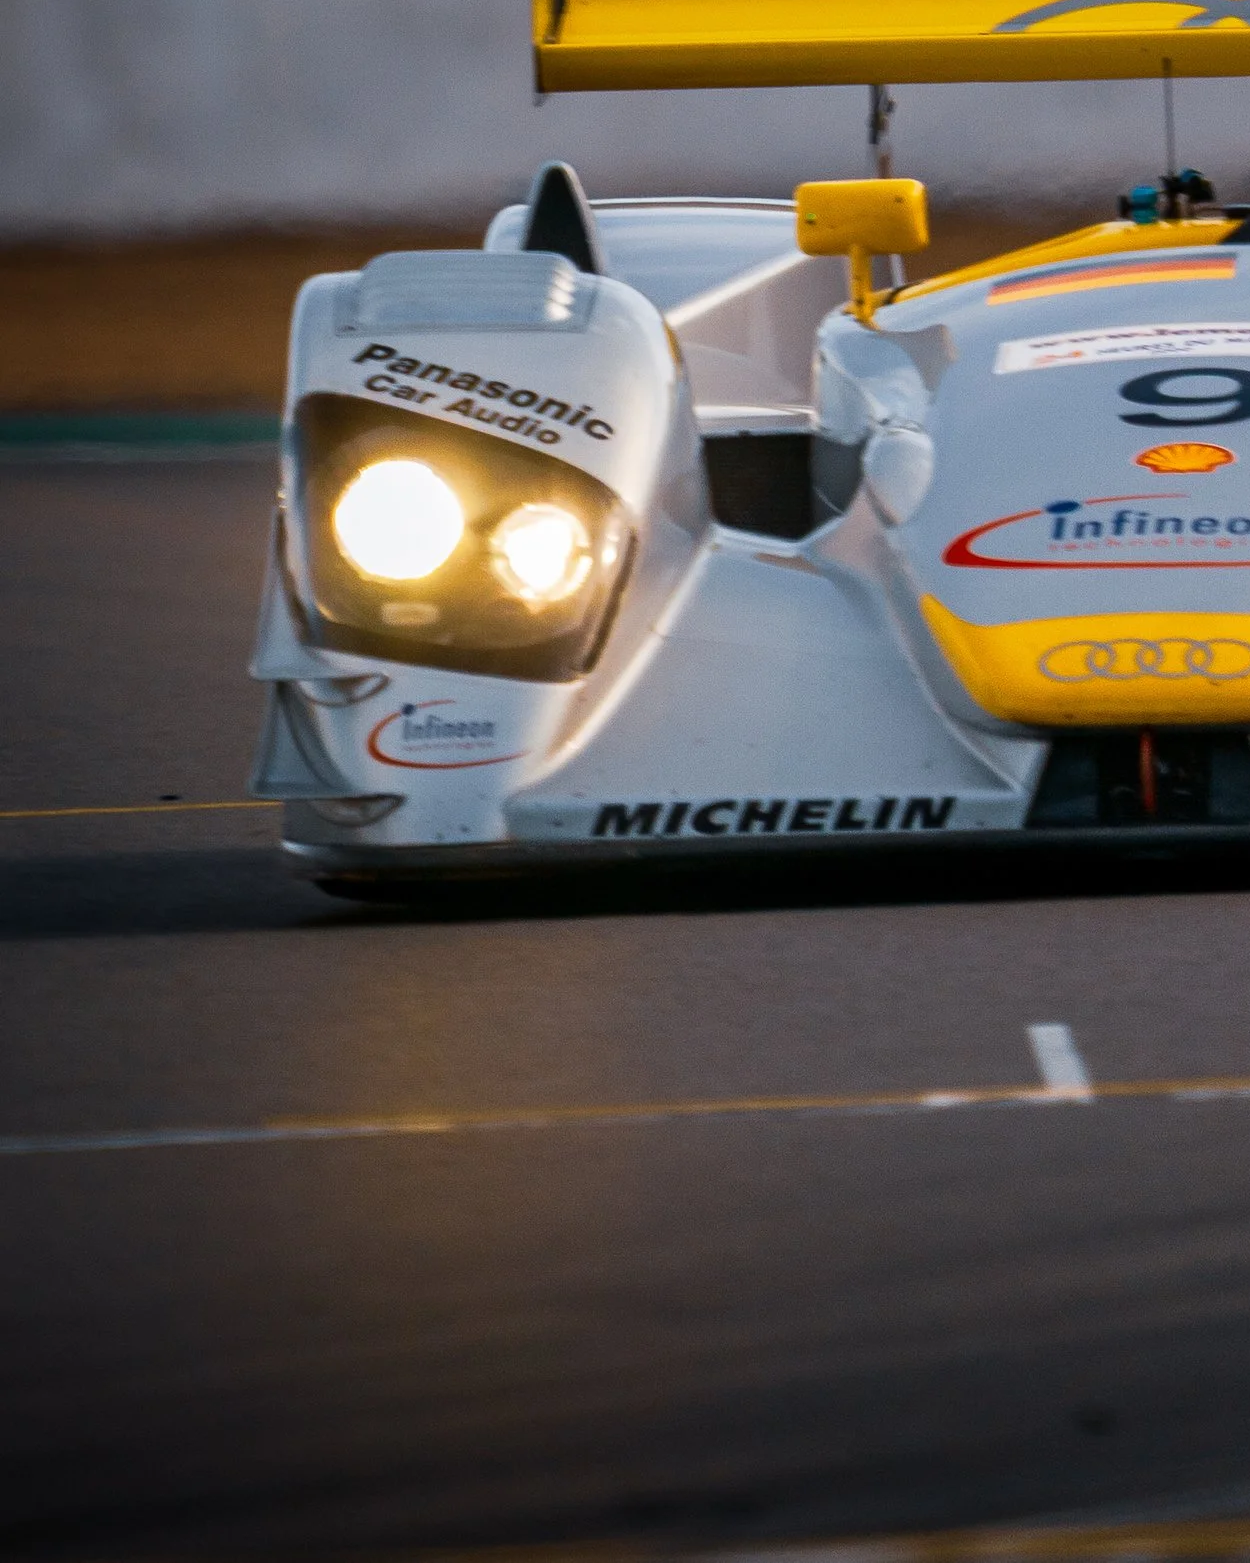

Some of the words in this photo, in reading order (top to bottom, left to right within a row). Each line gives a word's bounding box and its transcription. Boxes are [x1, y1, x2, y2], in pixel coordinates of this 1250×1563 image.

[352, 342, 615, 441] Panasonic
[364, 374, 438, 405] Car
[444, 397, 562, 446] Audio
[590, 794, 958, 838] MICHELIN
